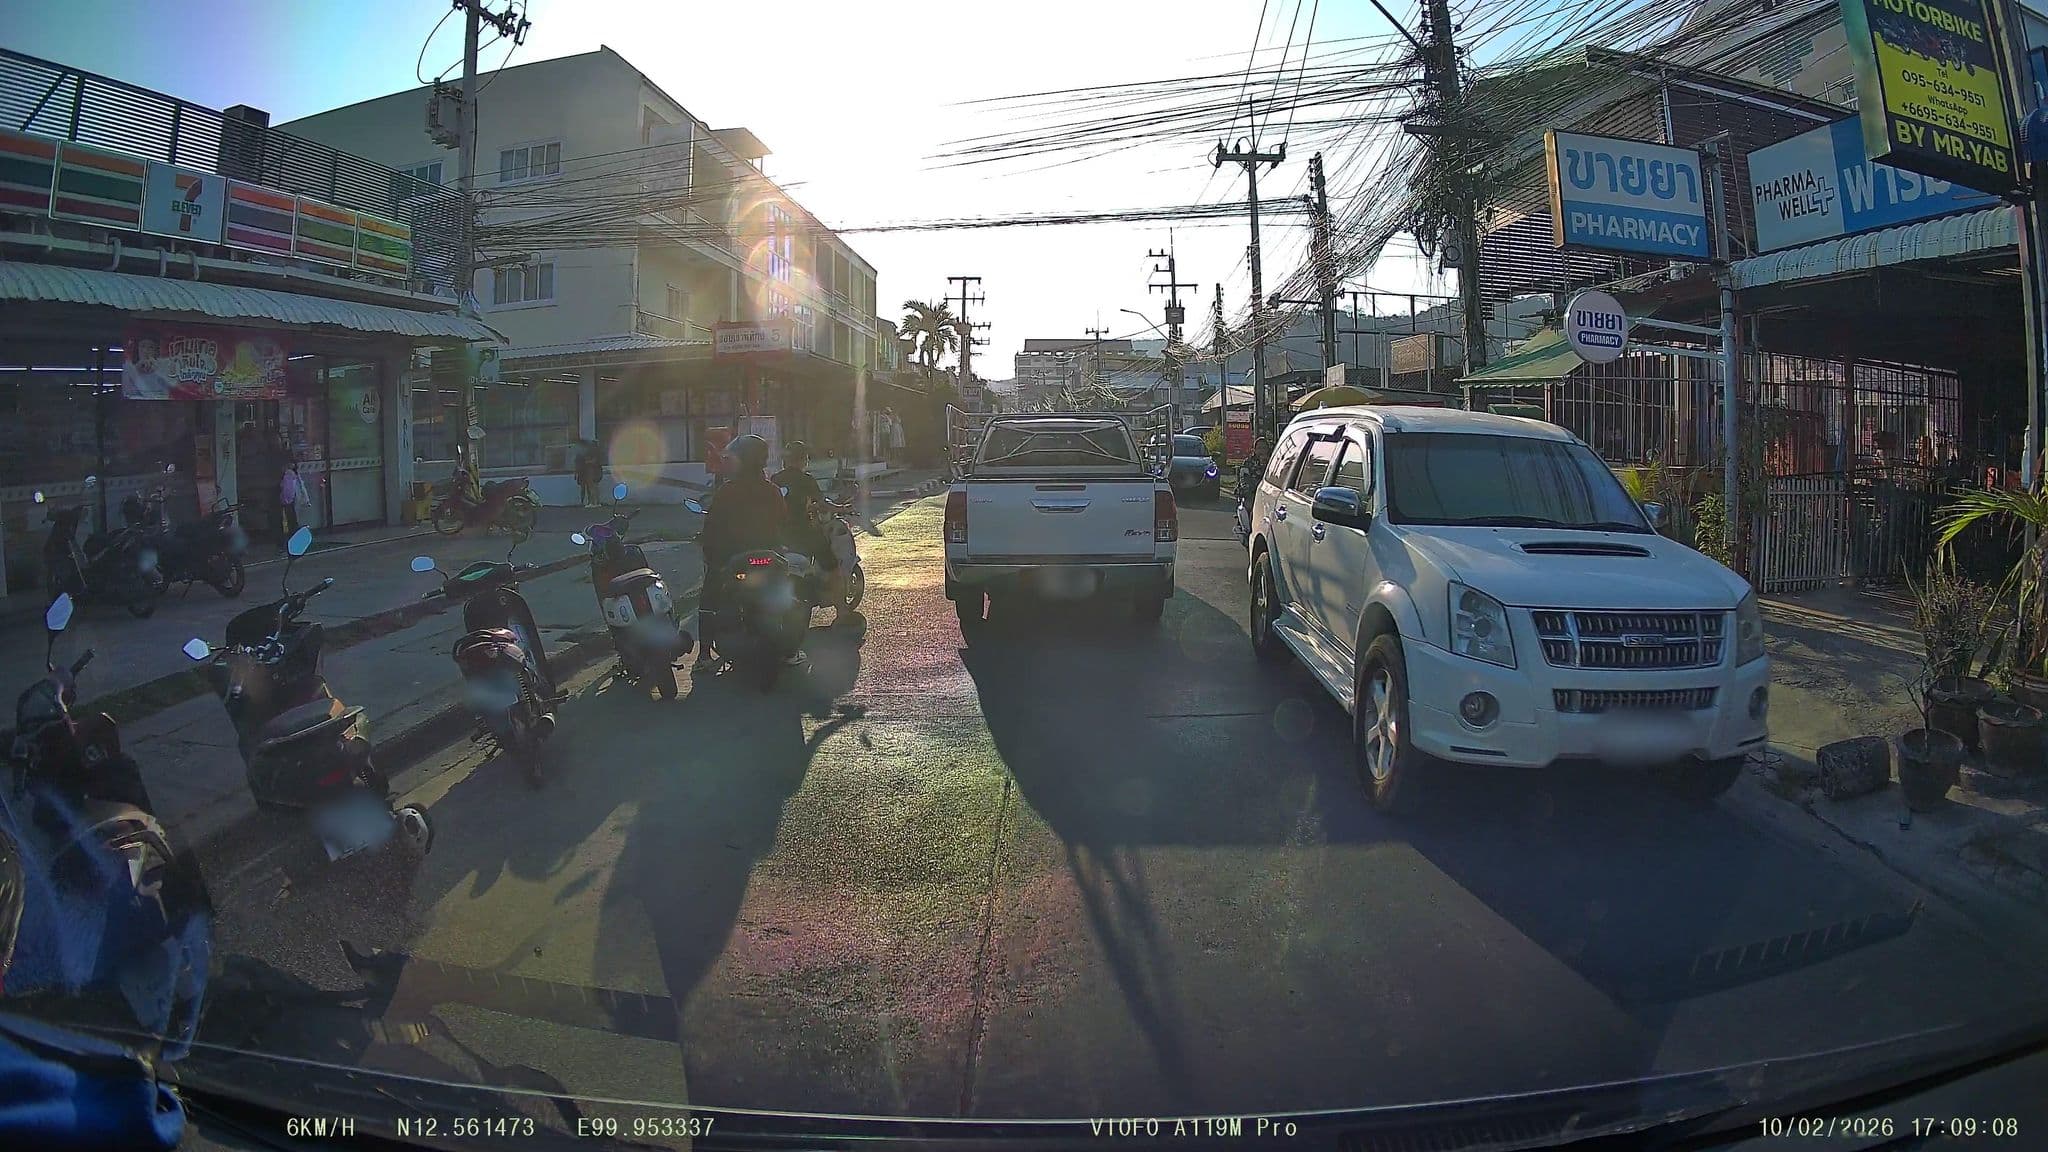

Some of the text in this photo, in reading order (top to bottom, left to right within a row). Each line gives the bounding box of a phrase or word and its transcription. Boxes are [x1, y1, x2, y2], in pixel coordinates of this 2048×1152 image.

[1902, 69, 1986, 108] 095-634-9551
[1936, 68, 1949, 79] Tel
[1902, 102, 1997, 141] +6695-634-9551
[1928, 95, 1969, 117] WhatsApp
[1895, 120, 2008, 173] BY MR.YAB
[1566, 149, 1697, 203] ขายยา
[1755, 169, 1816, 204] PHARMA
[1778, 195, 1818, 220] WELL
[1571, 211, 1700, 247] PHARMACY
[1577, 310, 1622, 331] ขายยา
[1581, 333, 1619, 346] PHARMACY
